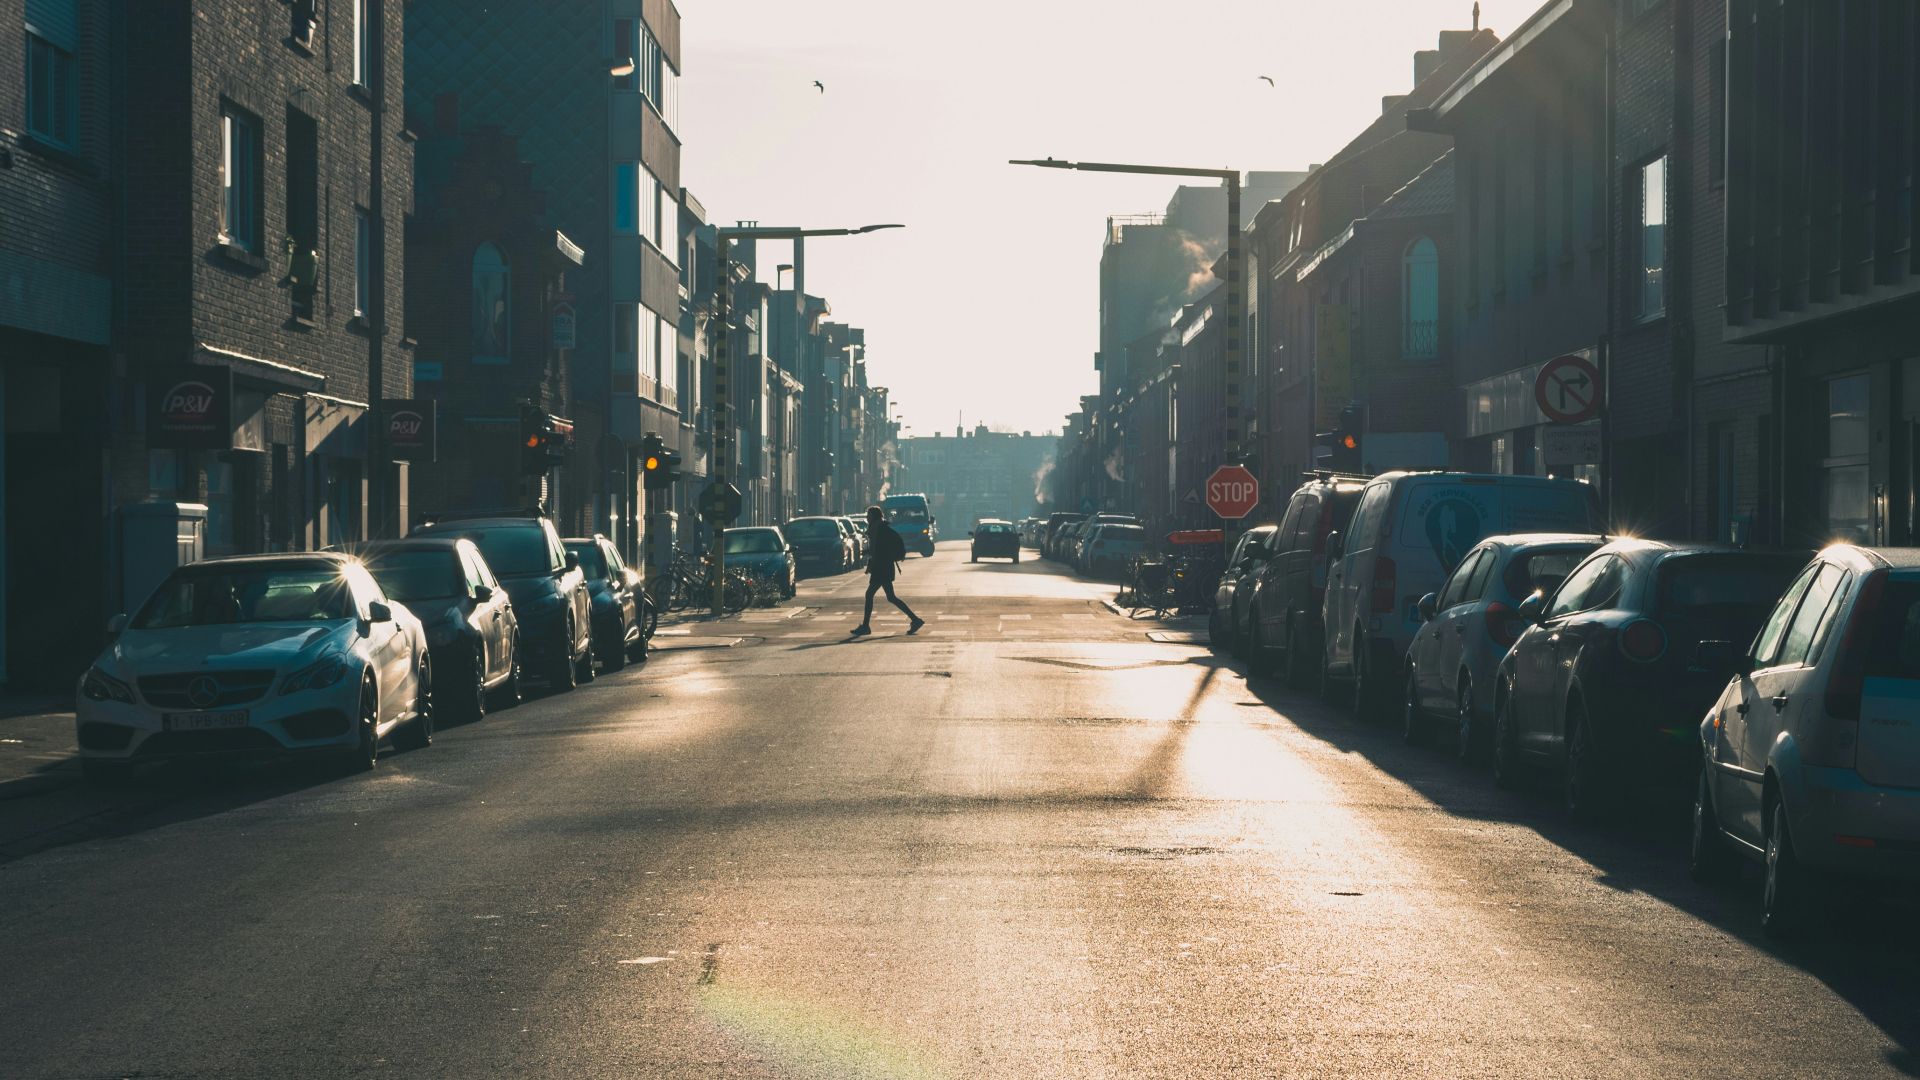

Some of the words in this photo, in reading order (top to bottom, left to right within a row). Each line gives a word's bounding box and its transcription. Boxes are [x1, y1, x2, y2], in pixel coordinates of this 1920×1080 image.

[168, 395, 213, 413] P&V
[390, 420, 422, 434] P&V
[1211, 482, 1254, 503] STOP
